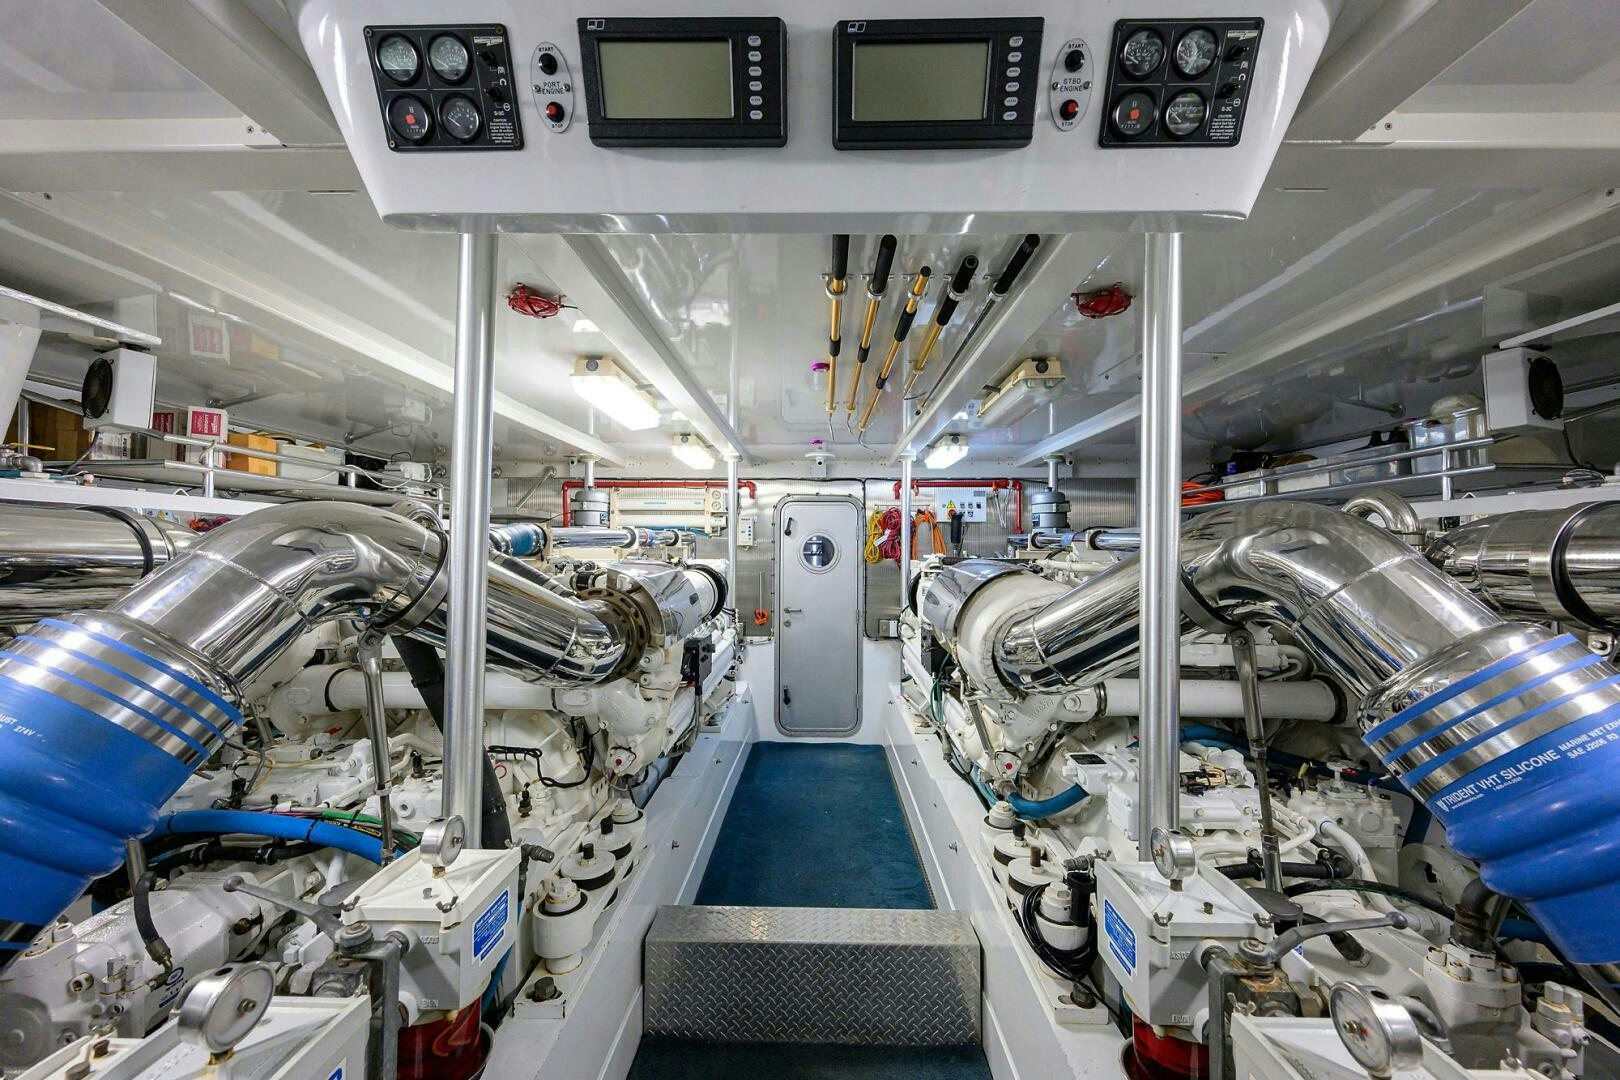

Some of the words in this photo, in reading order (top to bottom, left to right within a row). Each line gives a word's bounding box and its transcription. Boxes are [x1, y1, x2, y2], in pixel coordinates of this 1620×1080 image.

[0, 713, 18, 725] UST
[1557, 733, 1591, 752] MARINE
[1587, 725, 1608, 738] WET
[1566, 745, 1586, 759] SAE
[1443, 783, 1480, 807] TRIDENT
[1476, 773, 1501, 791] VHT
[1500, 749, 1561, 780] SILICONE
